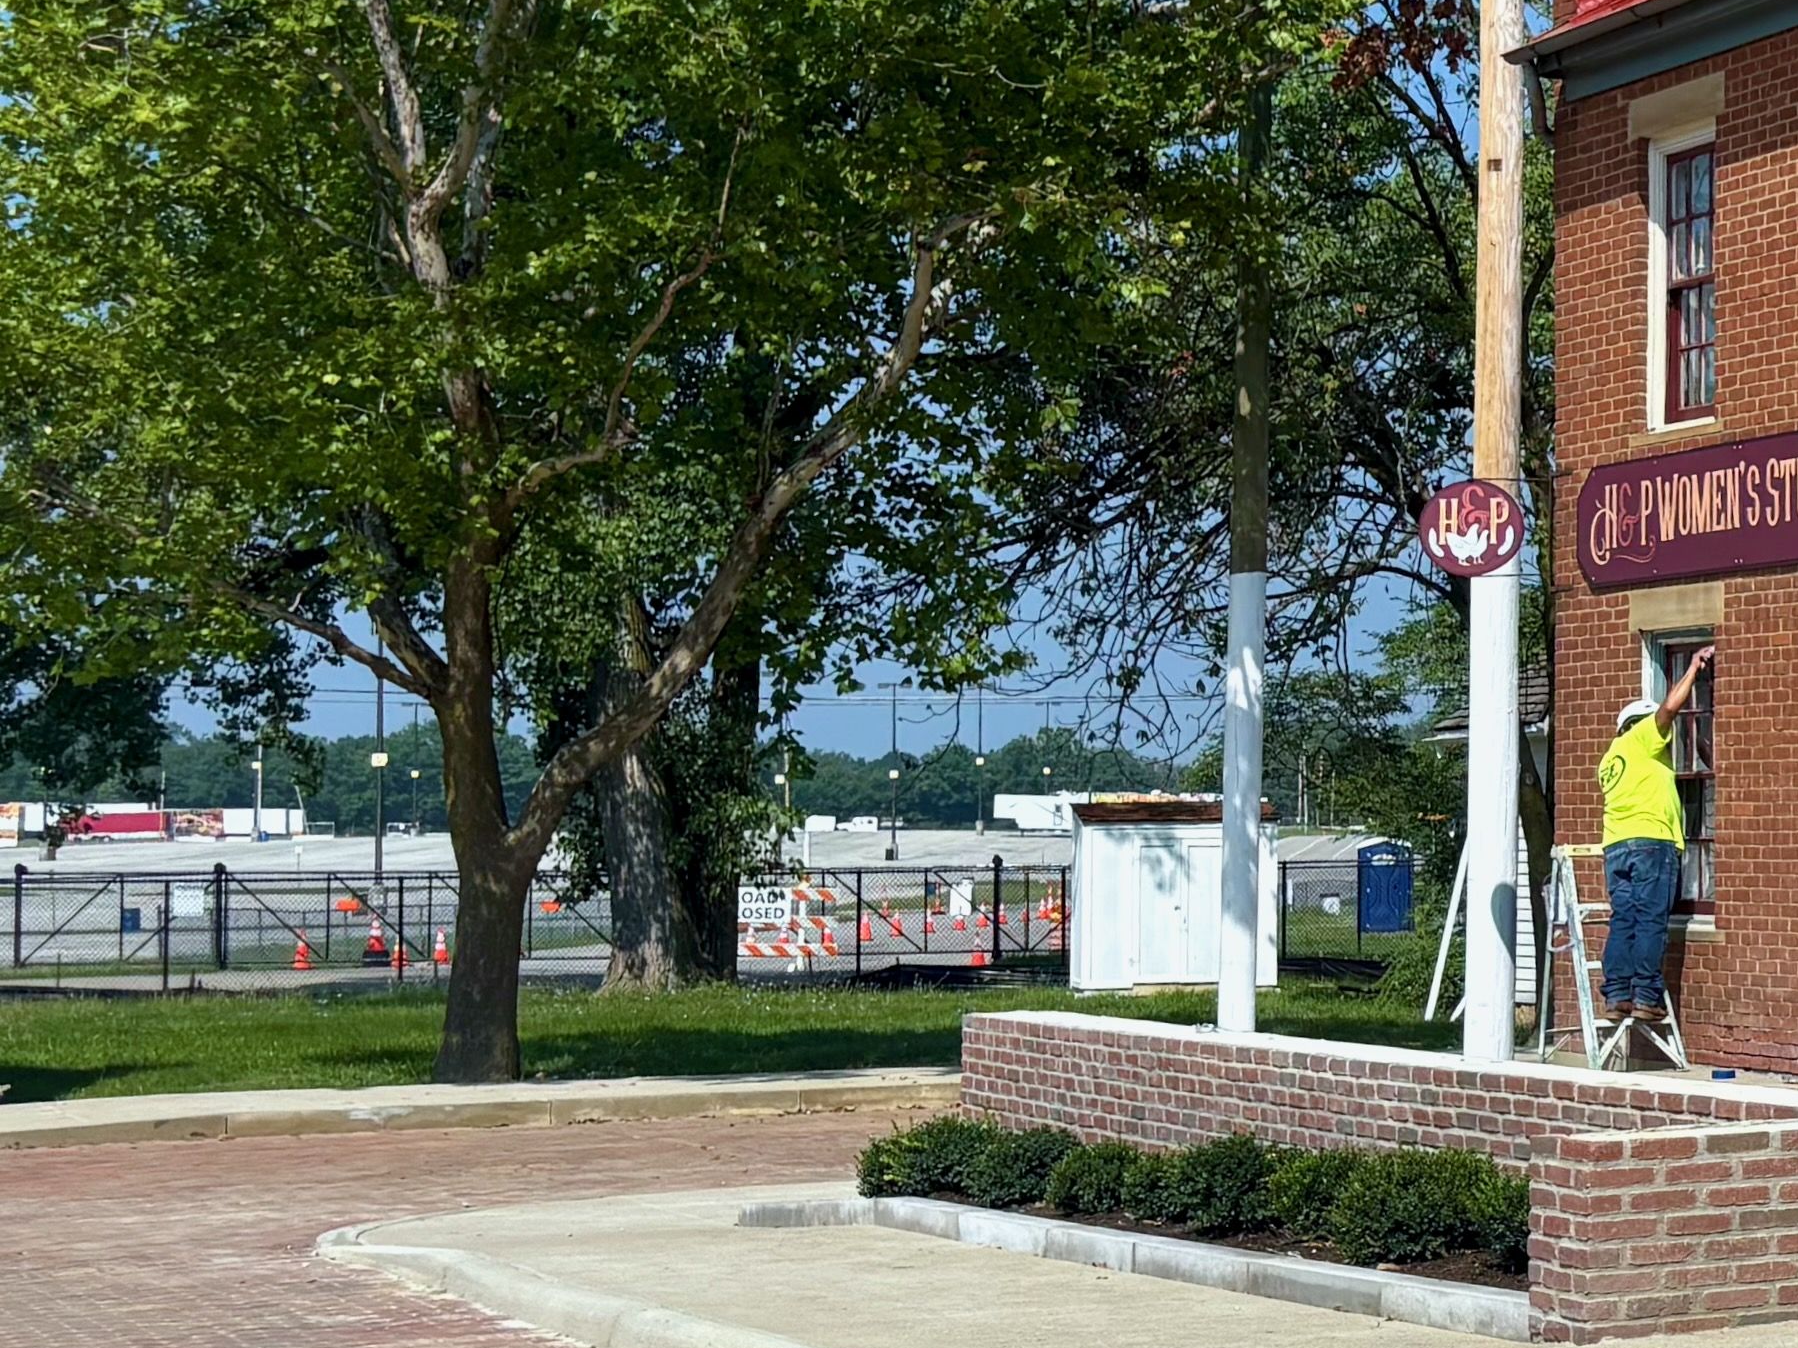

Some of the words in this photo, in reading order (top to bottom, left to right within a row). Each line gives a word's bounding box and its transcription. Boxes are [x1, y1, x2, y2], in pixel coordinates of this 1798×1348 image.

[1656, 460, 1760, 541] WOMEN'S
[742, 892, 778, 903] OAD
[742, 908, 785, 919] OSED
